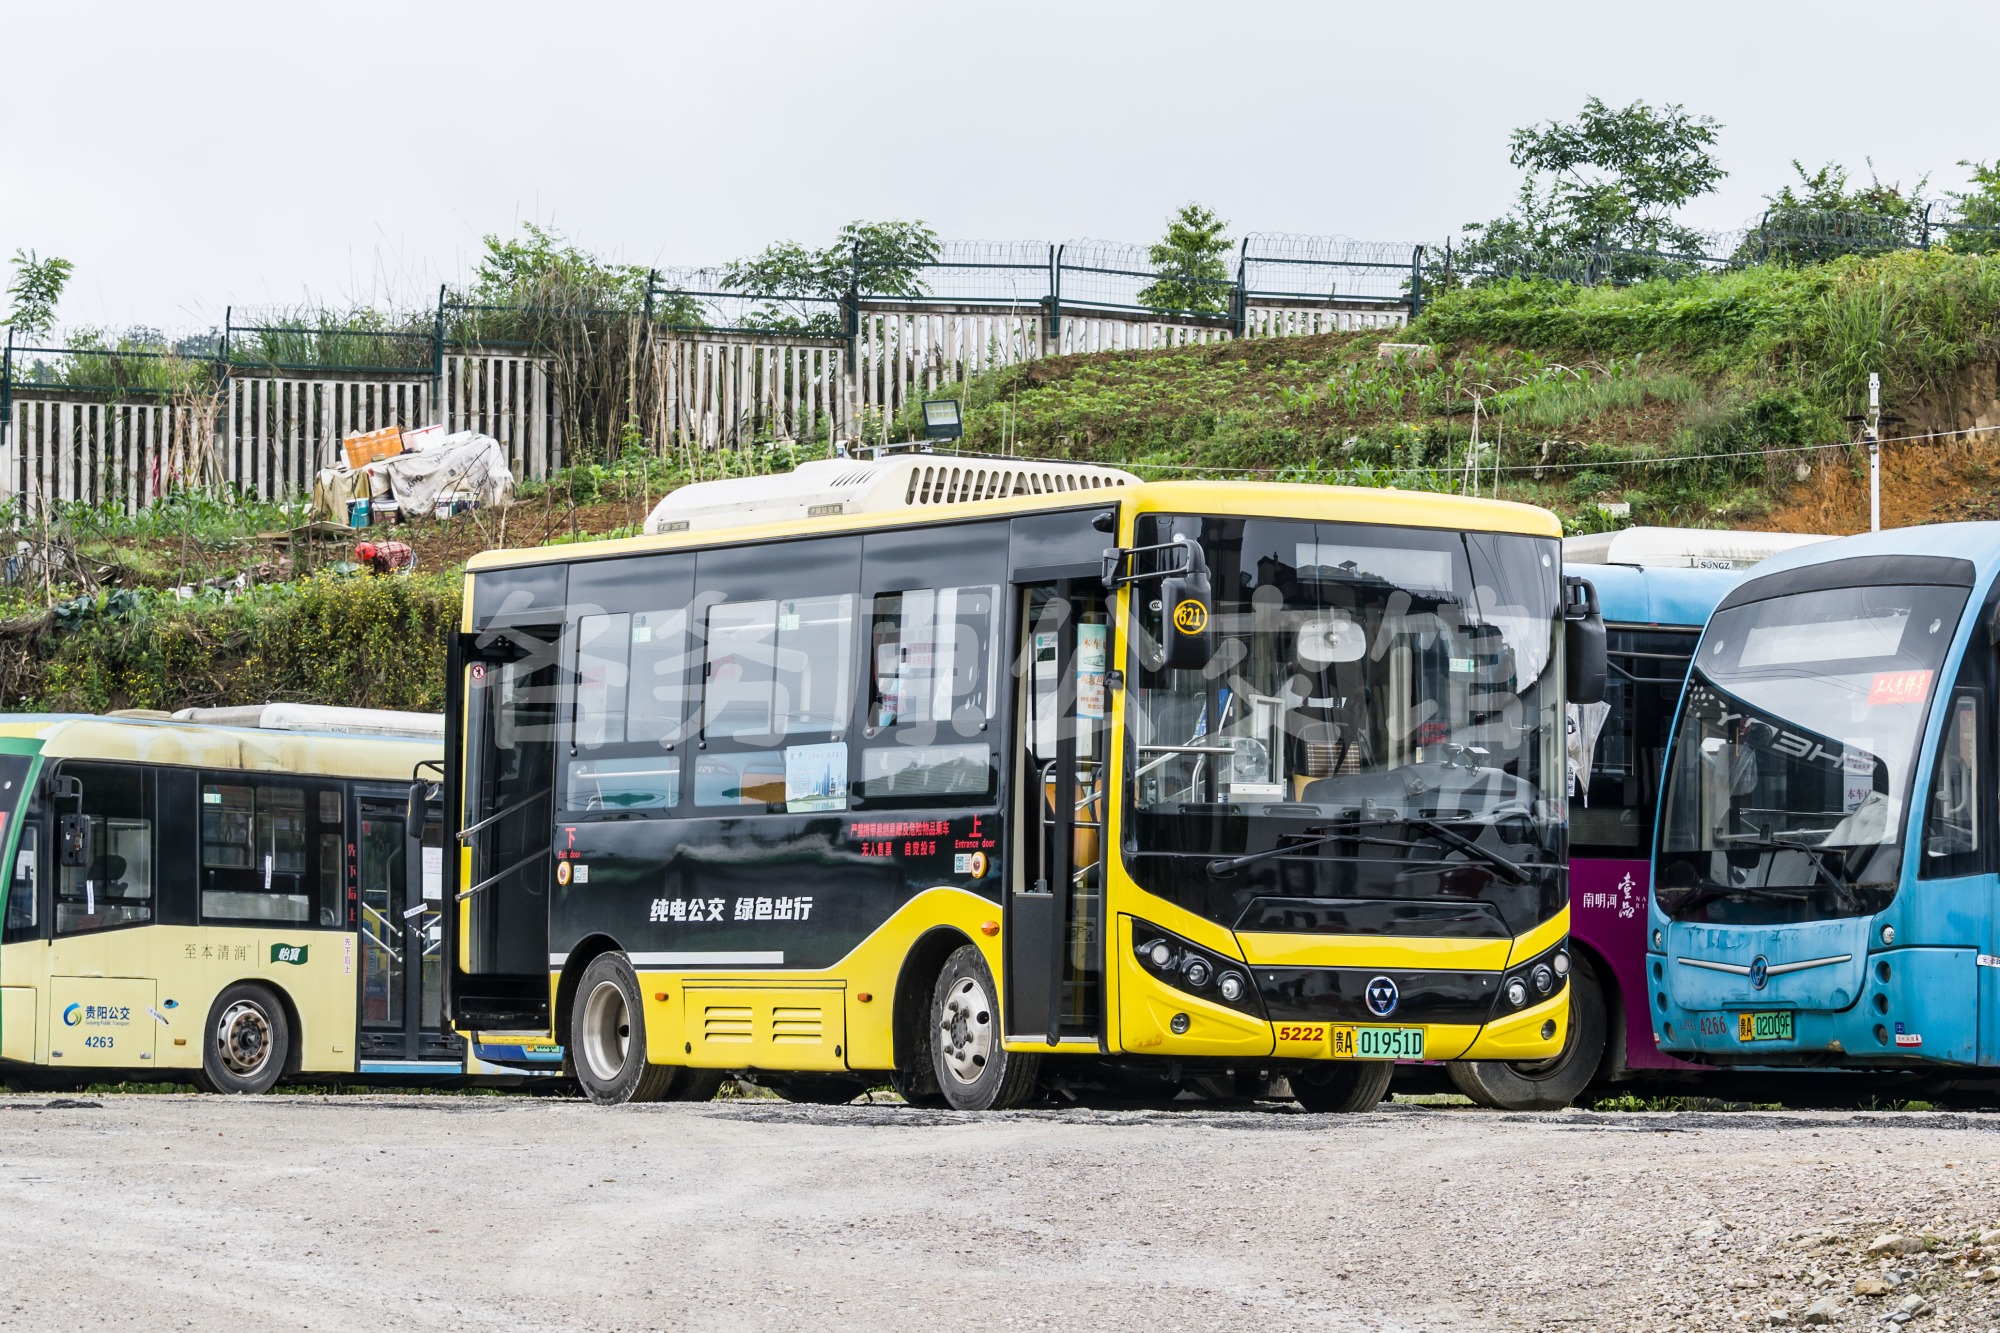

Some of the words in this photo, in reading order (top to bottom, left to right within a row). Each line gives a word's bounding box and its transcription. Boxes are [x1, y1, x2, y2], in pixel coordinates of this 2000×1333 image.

[1700, 561, 1730, 570] SONGZ
[1178, 606, 1201, 626] 621
[1874, 673, 1927, 697] 工人先锋号
[968, 813, 983, 838] 上
[565, 827, 577, 849] 下
[954, 839, 979, 849] Entrance
[981, 838, 996, 848] door
[861, 841, 893, 857] 无人售票
[904, 840, 936, 856] 自觉投币
[649, 897, 726, 922] 纯电公交
[733, 896, 813, 921] 绿色出行
[1583, 892, 1618, 909] 南明河
[184, 943, 246, 961] 至本清润
[85, 1005, 131, 1020] 贵阳公交
[1279, 1026, 1324, 1041] 5222
[1700, 1015, 1727, 1036] 4266
[1740, 1016, 1753, 1038] 贵A
[85, 1036, 114, 1048] 4263
[1335, 1030, 1353, 1054] 贵A
[1361, 1031, 1422, 1055] 01951D
